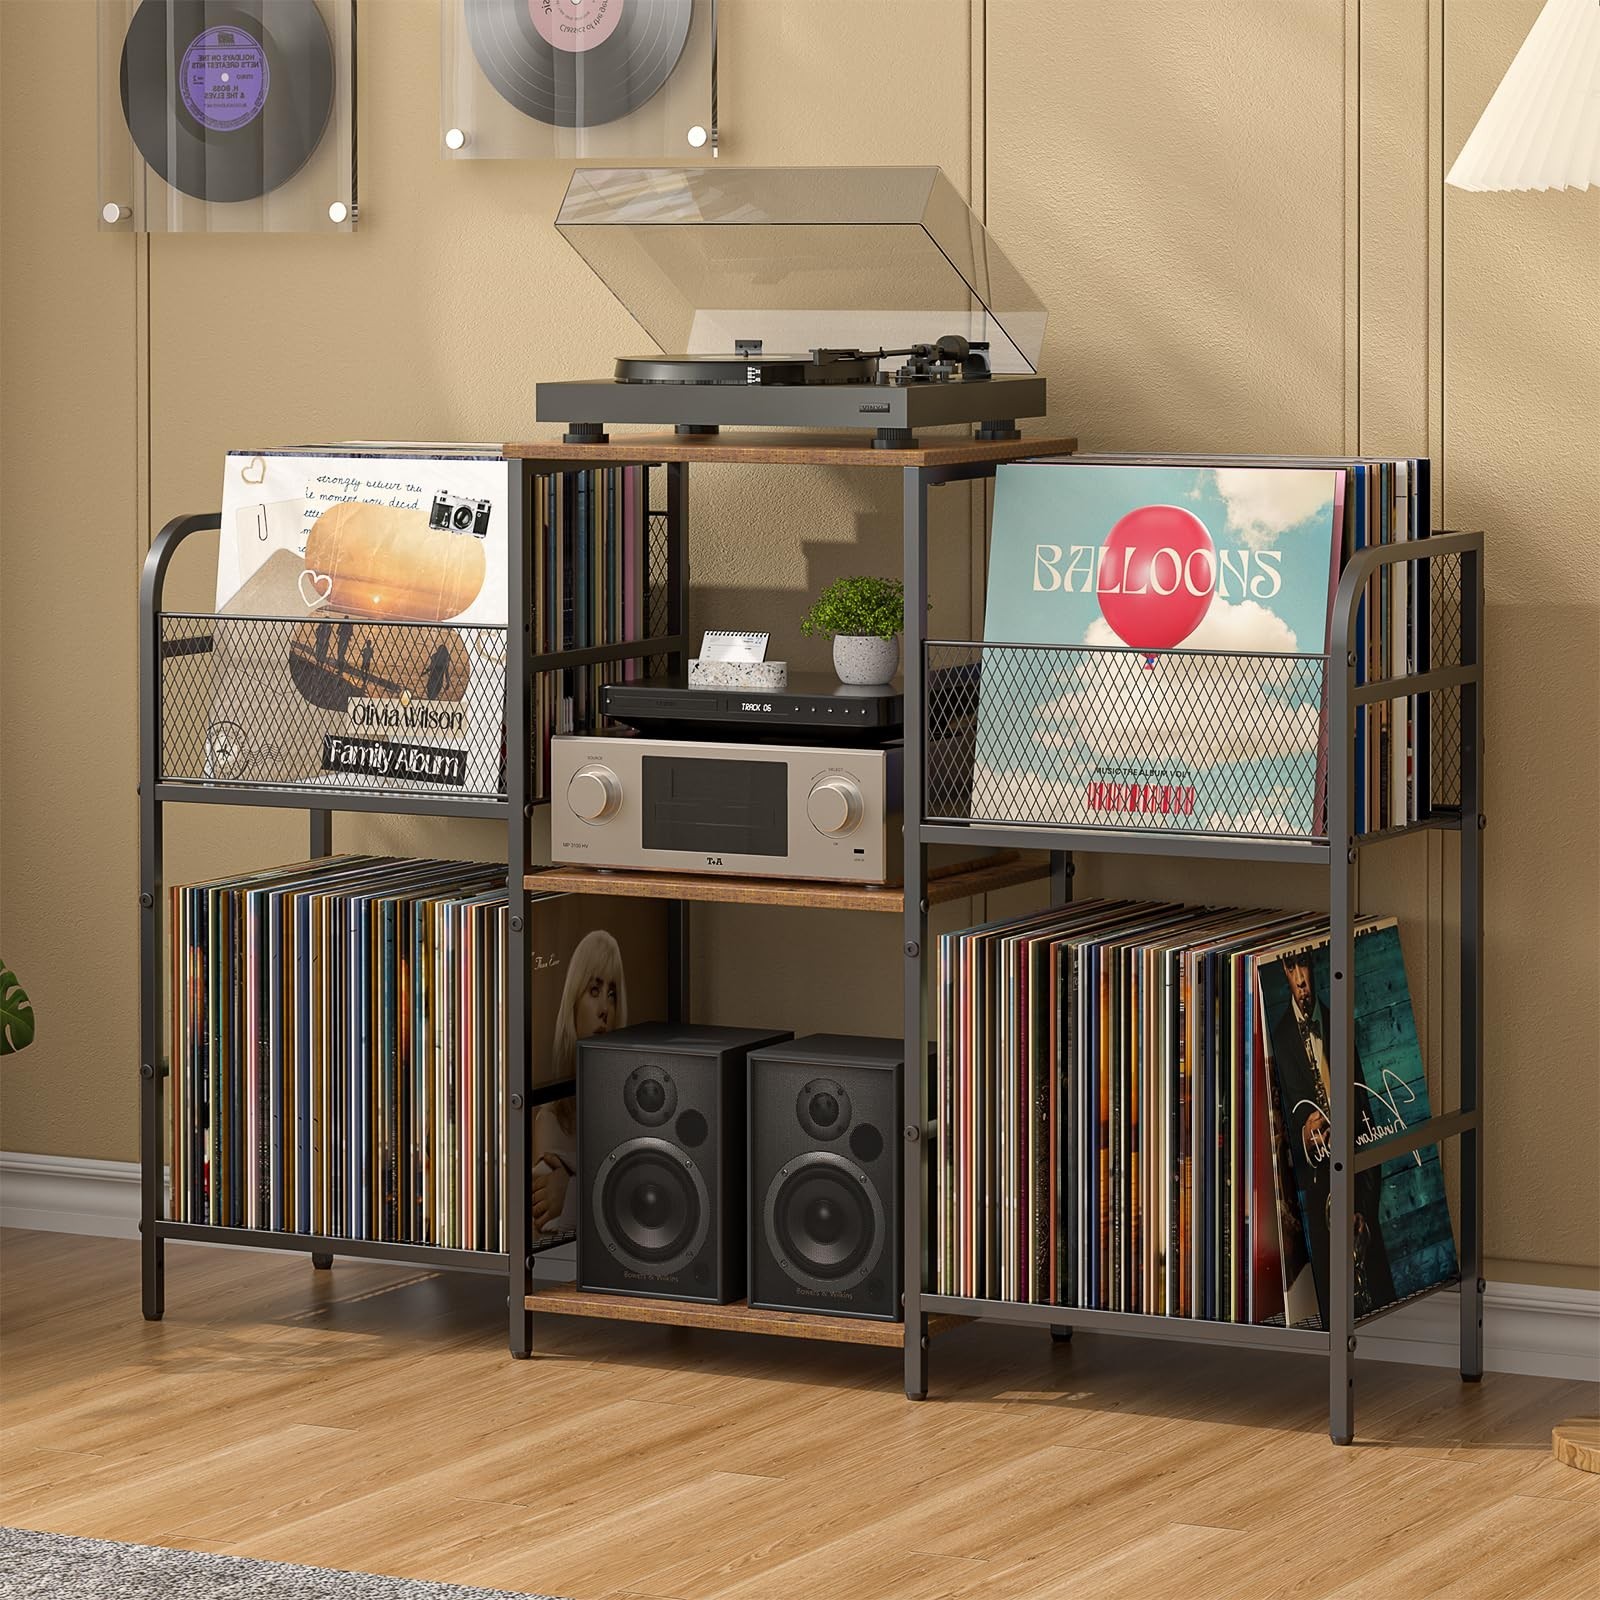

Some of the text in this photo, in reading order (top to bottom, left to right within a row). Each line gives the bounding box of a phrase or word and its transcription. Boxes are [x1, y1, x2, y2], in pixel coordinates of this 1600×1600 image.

[316, 475, 362, 492] strongly
[319, 494, 357, 502] moment
[1032, 544, 1282, 598] BALLOONS
[352, 704, 462, 731] Olivia Wilson
[741, 703, 761, 711] TRACK
[329, 739, 459, 777] Family Album
